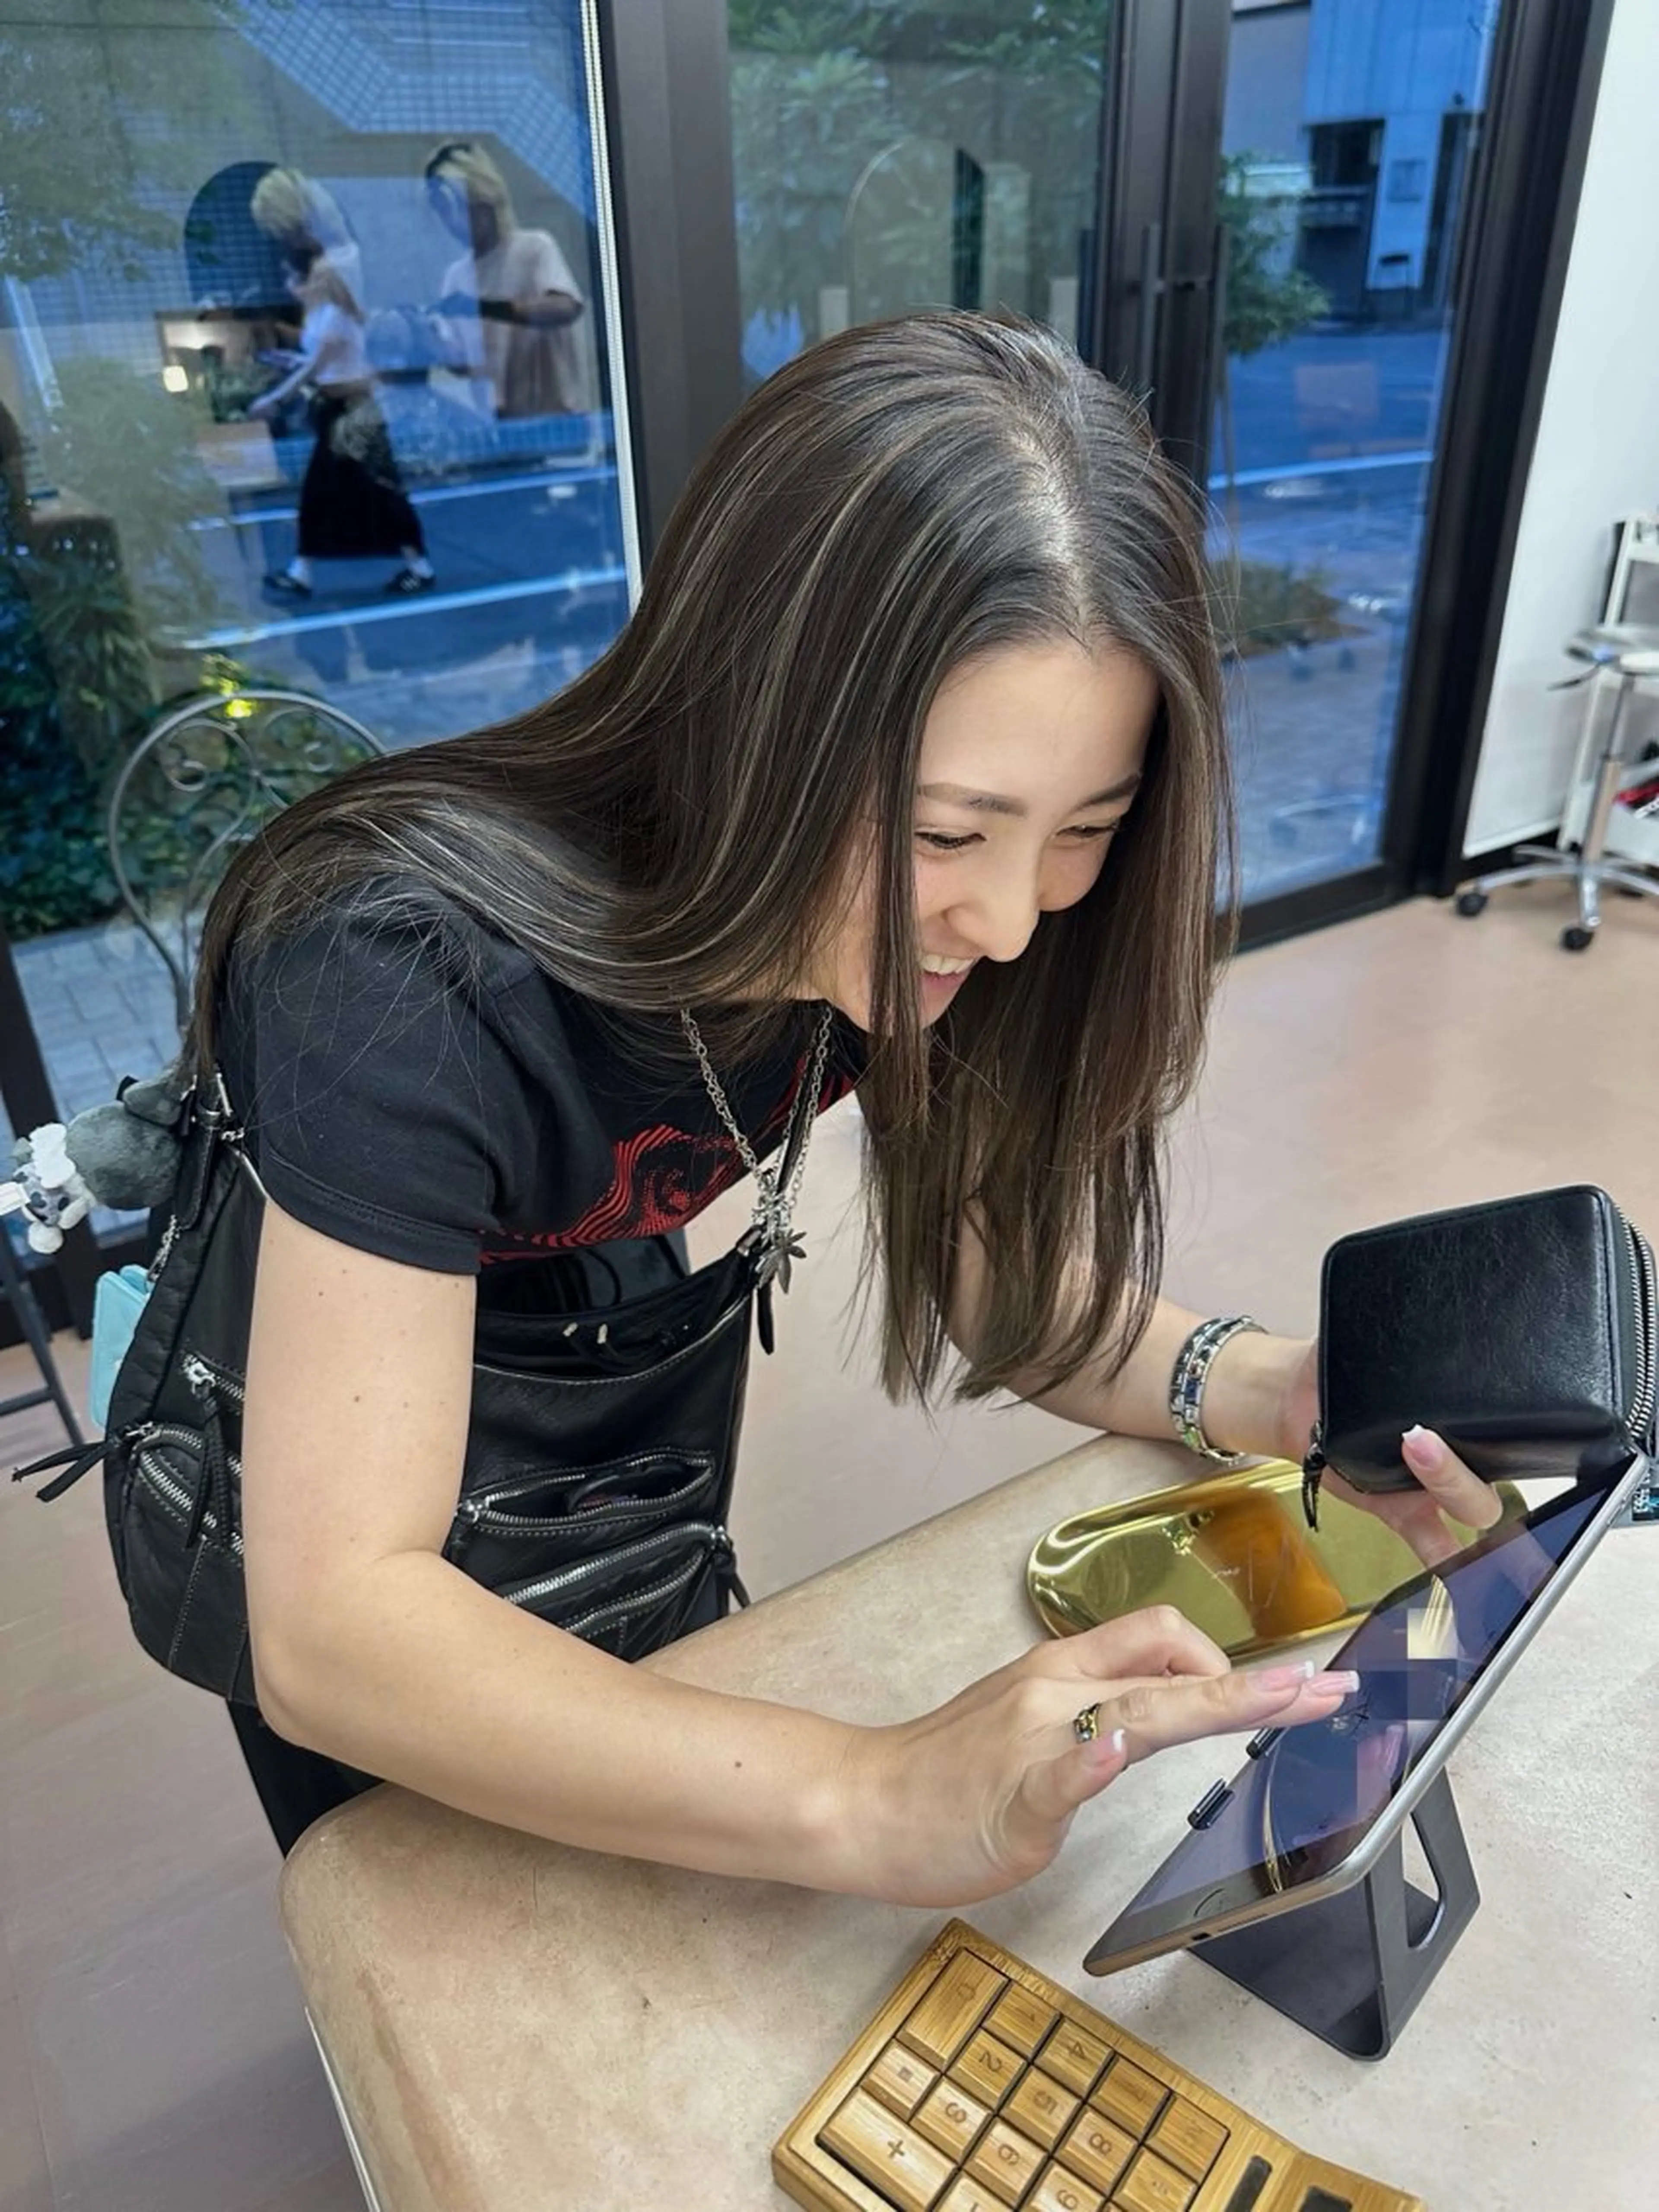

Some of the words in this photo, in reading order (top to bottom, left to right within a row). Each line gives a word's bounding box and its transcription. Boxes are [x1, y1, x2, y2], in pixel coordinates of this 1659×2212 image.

[979, 2048, 1002, 2072] 2
[1068, 2040, 1086, 2059] 4
[945, 2102, 967, 2123] 3
[1034, 2091, 1058, 2114] 5
[998, 2143, 1020, 2165] 6
[1089, 2133, 1112, 2155] 8
[1056, 2190, 1079, 2210] 9
